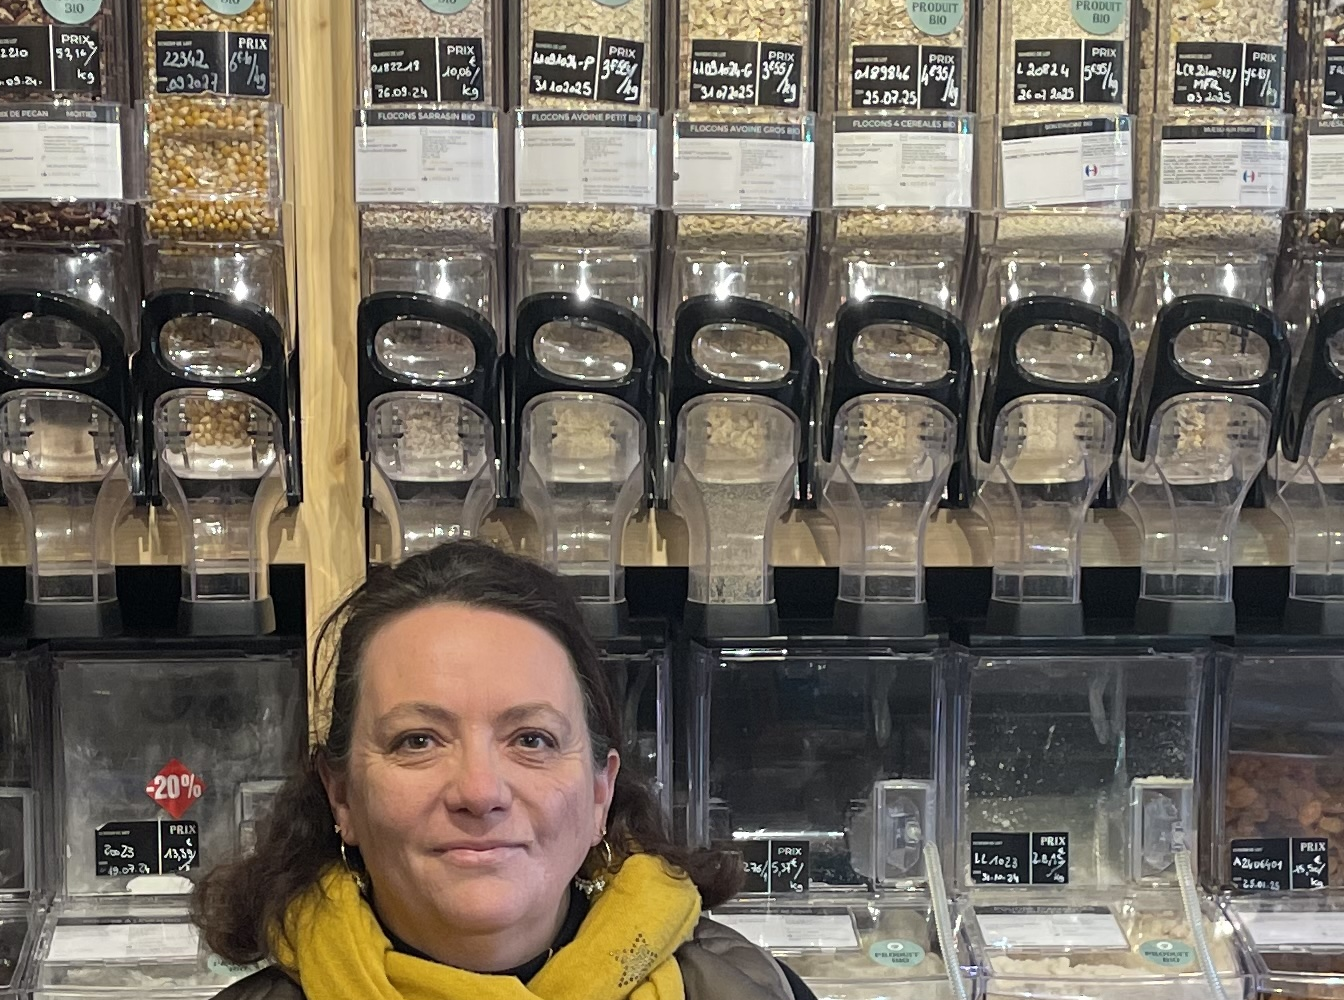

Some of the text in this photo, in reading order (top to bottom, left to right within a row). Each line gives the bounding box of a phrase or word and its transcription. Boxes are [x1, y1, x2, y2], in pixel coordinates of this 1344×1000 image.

[912, 3, 959, 14] PRODUIT
[1075, 1, 1123, 12] PRODUIT
[928, 15, 947, 26] BIO
[1092, 13, 1111, 24] BIO
[61, 34, 89, 45] PRIX
[238, 37, 267, 50] PRIX
[447, 45, 475, 55] PRIX
[609, 46, 636, 58] PRIX
[1091, 48, 1117, 58] PRIX
[768, 52, 795, 62] PRIX
[929, 54, 955, 64] PRIX
[1253, 52, 1277, 62] PRIX
[77, 69, 95, 84] kg
[462, 85, 479, 99] kg
[21, 110, 49, 118] PECAN
[377, 112, 476, 121] FLOCONS SARRASIN BIO
[532, 113, 642, 123] FLOCONS AVOINE PETIT BIO
[852, 119, 892, 128] FLOCONS
[942, 120, 956, 128] BIO
[690, 125, 800, 135] FLOCONS AVOINE GROS BIO
[146, 774, 203, 800] -20%
[169, 824, 196, 835] PRIX
[1040, 836, 1066, 846] PRIX
[777, 847, 802, 856] PRIX
[1300, 842, 1326, 852] PRIX
[789, 880, 803, 892] kg
